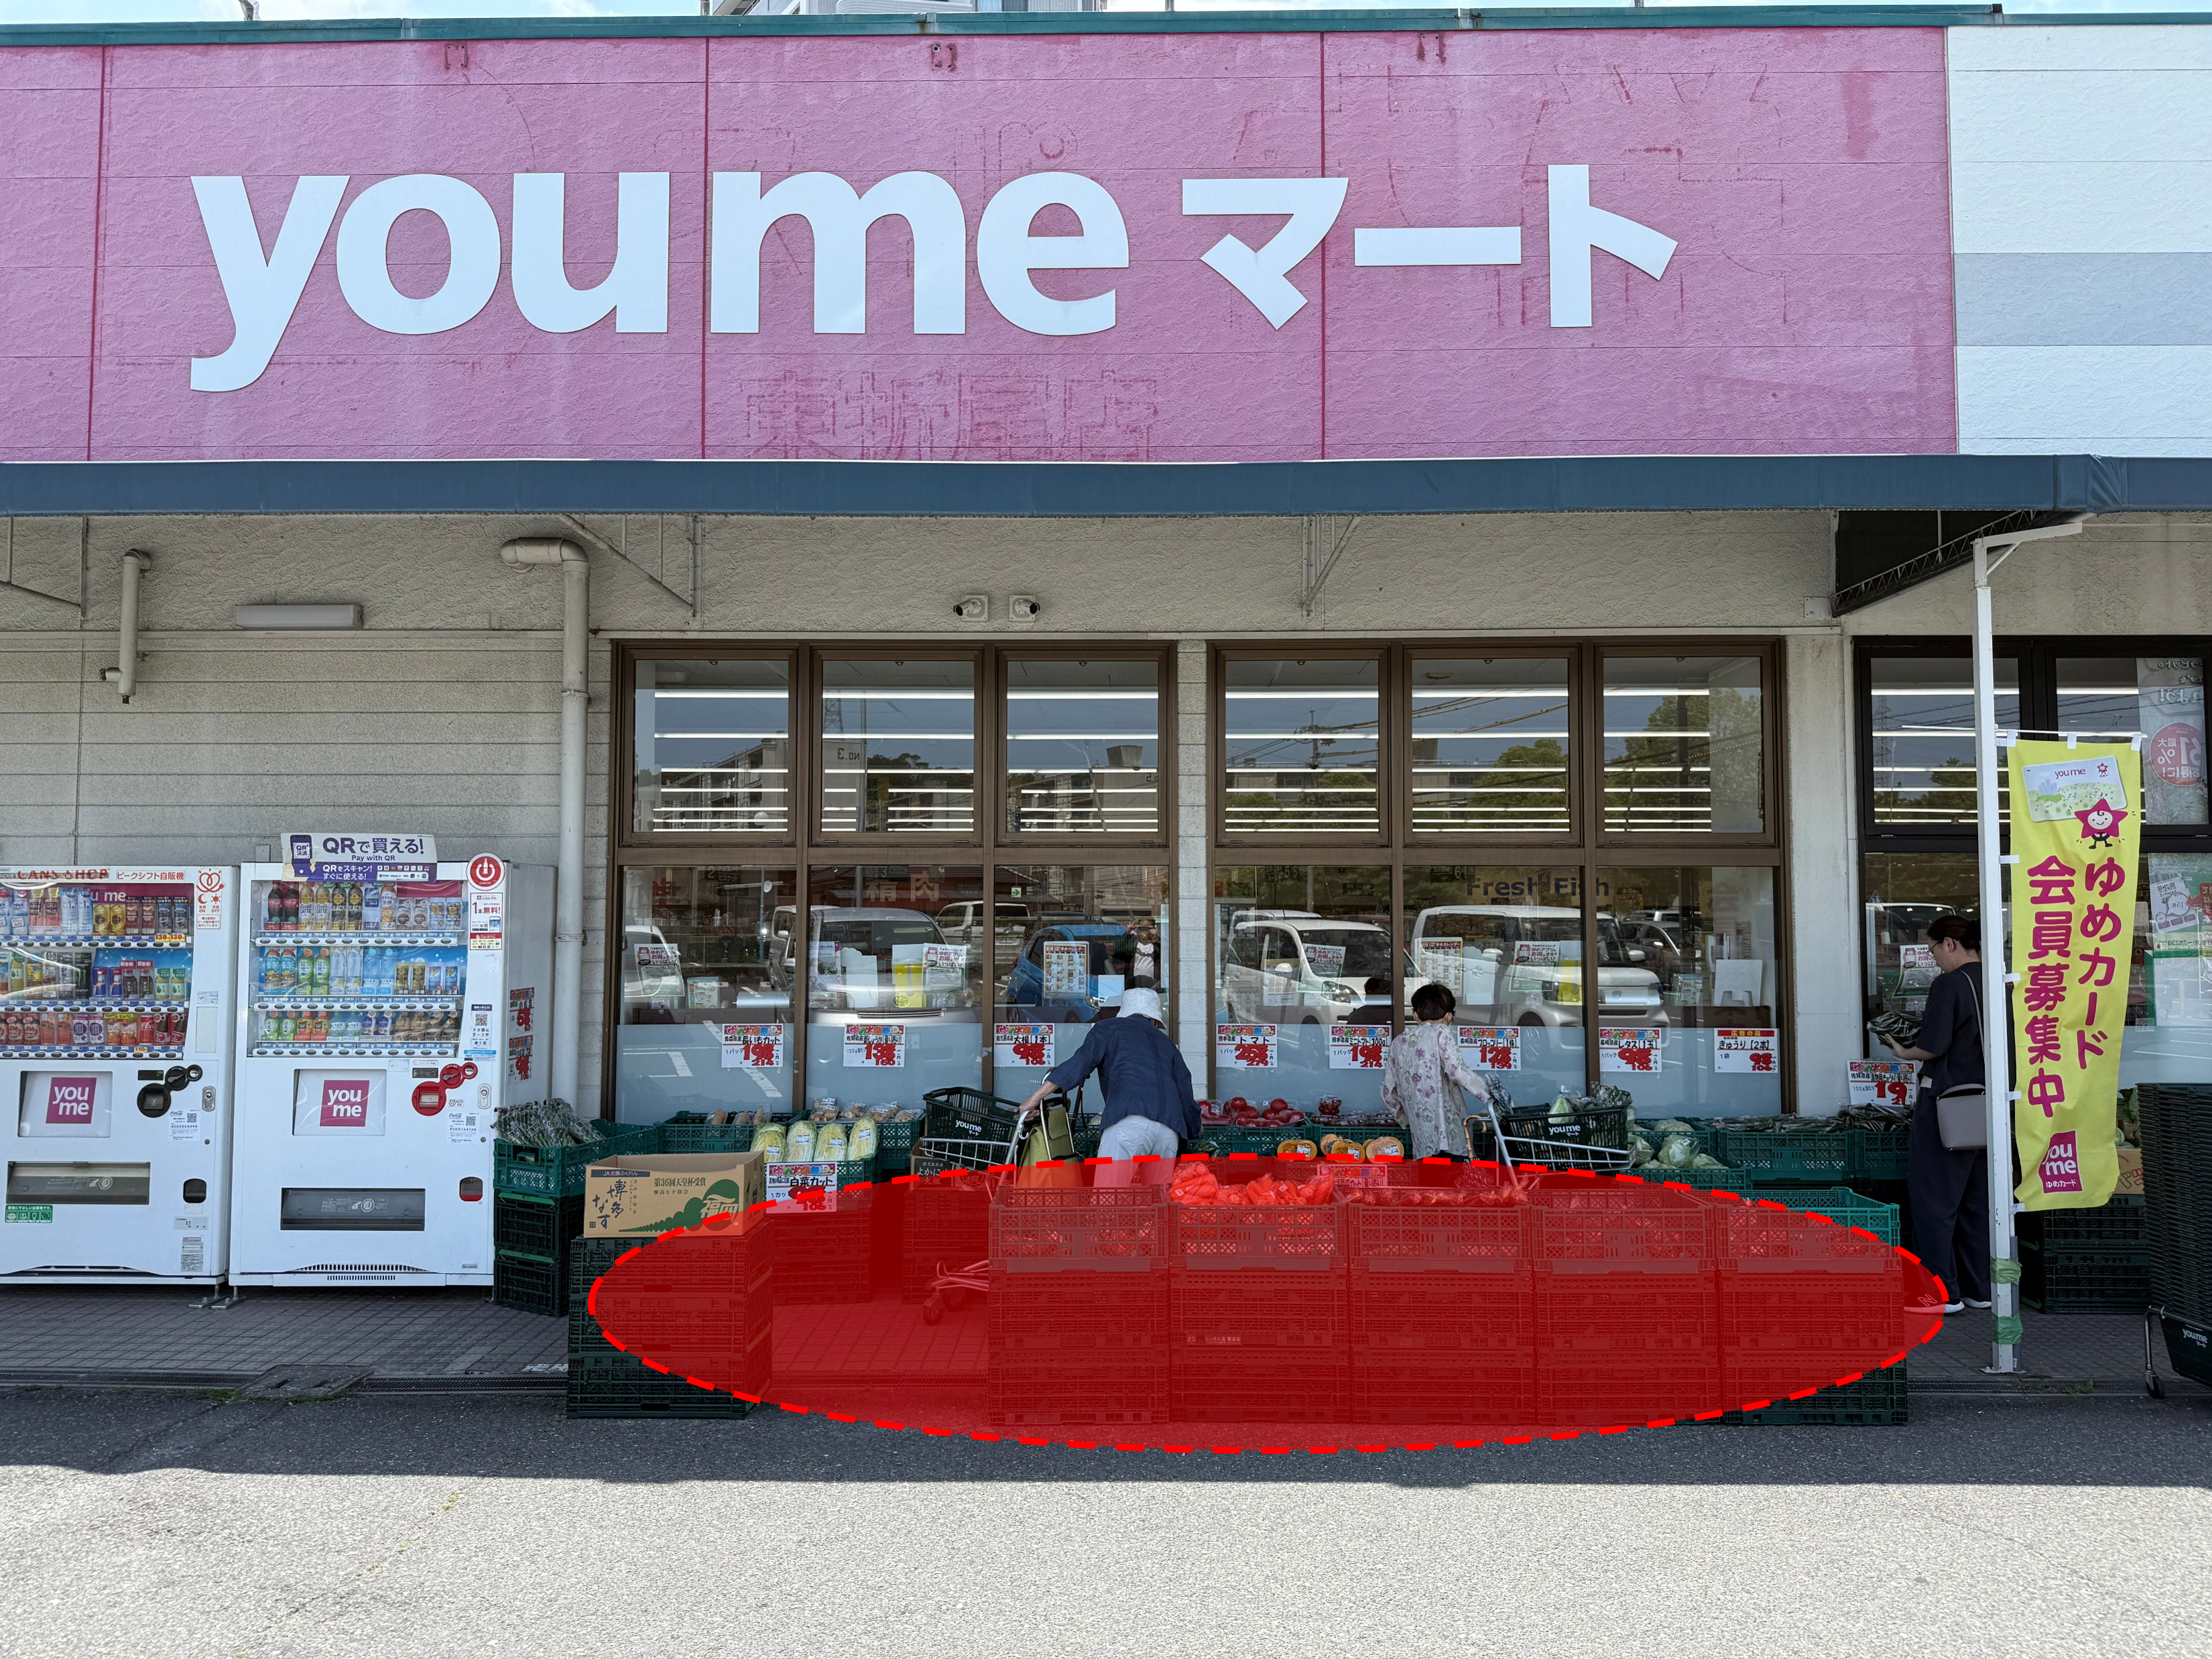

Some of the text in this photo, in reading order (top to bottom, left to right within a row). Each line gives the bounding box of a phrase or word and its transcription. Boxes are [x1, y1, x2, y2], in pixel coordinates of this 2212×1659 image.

[1182, 164, 1678, 329] マート
[323, 838, 424, 854] QRで買える!
[117, 871, 184, 880] ピークシフト自販機
[1468, 877, 1609, 896] Fresh Fih
[2077, 857, 2126, 1070] ゆめカード
[2024, 855, 2076, 1118] 会員募集中
[742, 1036, 780, 1044] 長いもカット
[1240, 1036, 1270, 1044] トマト
[743, 1044, 774, 1060] 198
[865, 1043, 896, 1059] 138
[1012, 1044, 1045, 1059] 98
[1351, 1046, 1382, 1061] 198
[1479, 1047, 1512, 1063] 128
[1617, 1048, 1652, 1064] 98
[1749, 1053, 1772, 1064] 98
[54, 1086, 89, 1103] you
[328, 1089, 362, 1106] you
[1874, 1082, 1907, 1098] 19
[58, 1102, 89, 1115] me
[332, 1104, 362, 1117] me
[955, 1119, 982, 1132] youme
[1548, 1125, 1581, 1135] youme
[2046, 1160, 2077, 1175] me
[654, 1177, 706, 1186] 第36回天皇杯受賞
[790, 1176, 833, 1186] 白菜カット
[2046, 1179, 2077, 1188] ゆめカード
[607, 1179, 627, 1218] 博多
[593, 1194, 611, 1229] なす
[2183, 1329, 2208, 1343] youme
